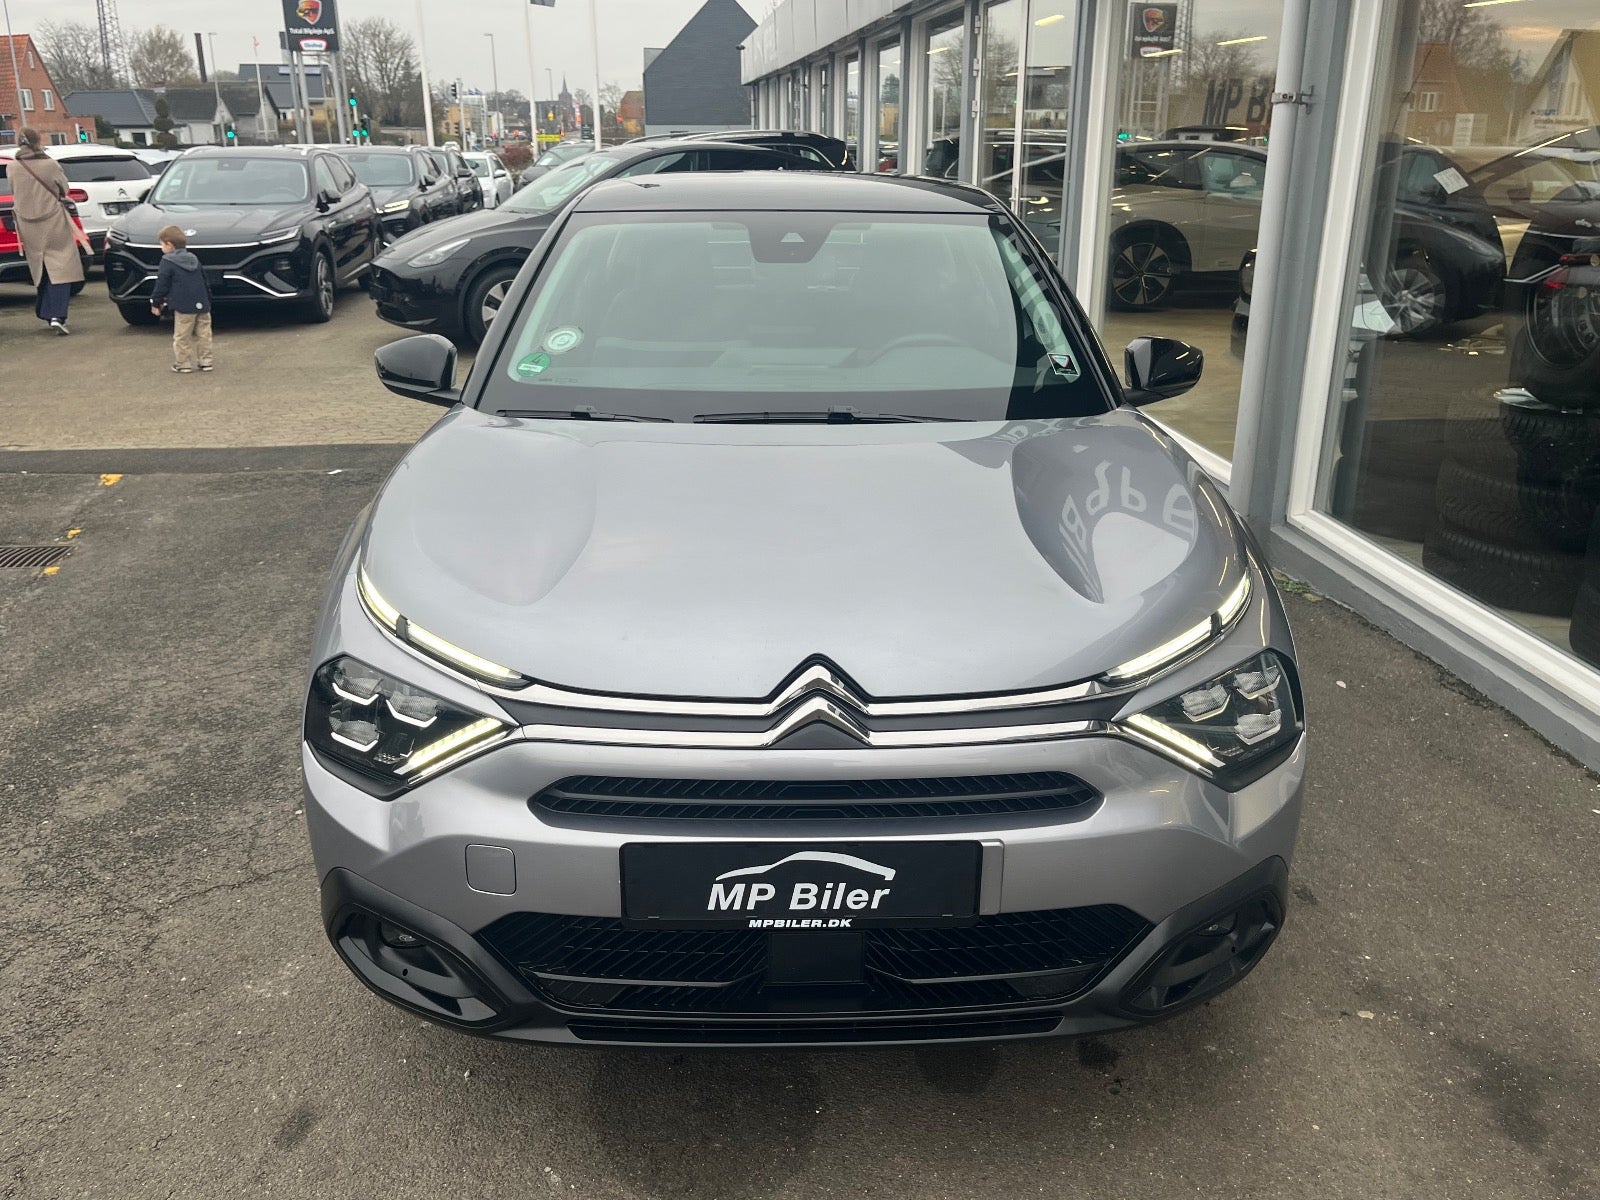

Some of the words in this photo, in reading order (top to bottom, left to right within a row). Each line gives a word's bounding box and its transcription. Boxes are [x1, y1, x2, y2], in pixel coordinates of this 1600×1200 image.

[1202, 79, 1244, 125] MP
[707, 883, 776, 911] MP
[788, 882, 891, 911] Biler
[748, 918, 853, 929] MPBILER.DK
